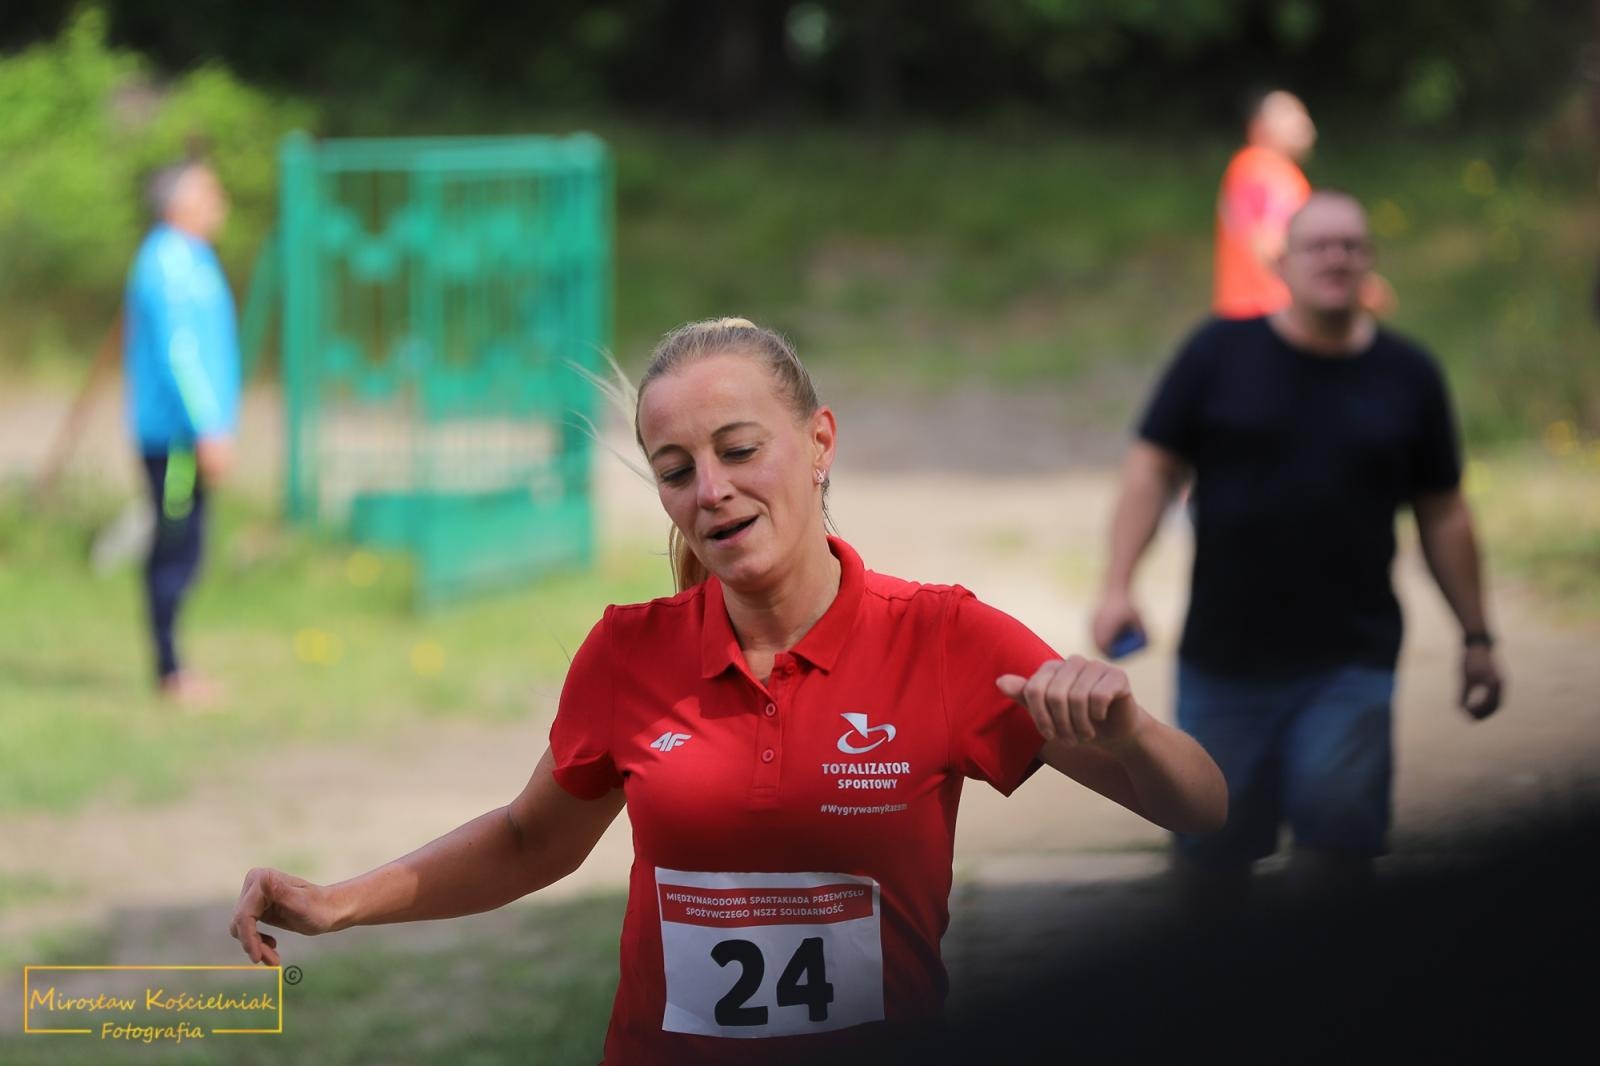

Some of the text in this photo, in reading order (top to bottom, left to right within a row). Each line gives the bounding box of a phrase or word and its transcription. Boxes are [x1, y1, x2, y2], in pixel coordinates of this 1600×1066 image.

[650, 732, 692, 752] 4F
[822, 762, 910, 775] TOTALIZATOR
[837, 779, 898, 789] SPORTOWY
[666, 889, 864, 906] MIĘDZYNARODOWA SPARTAKIADA PRZEMYSŁU
[685, 902, 844, 919] SPOŻYWCZEGO NSZZ SOLIDARNOŚĆ
[710, 936, 834, 1027] 24
